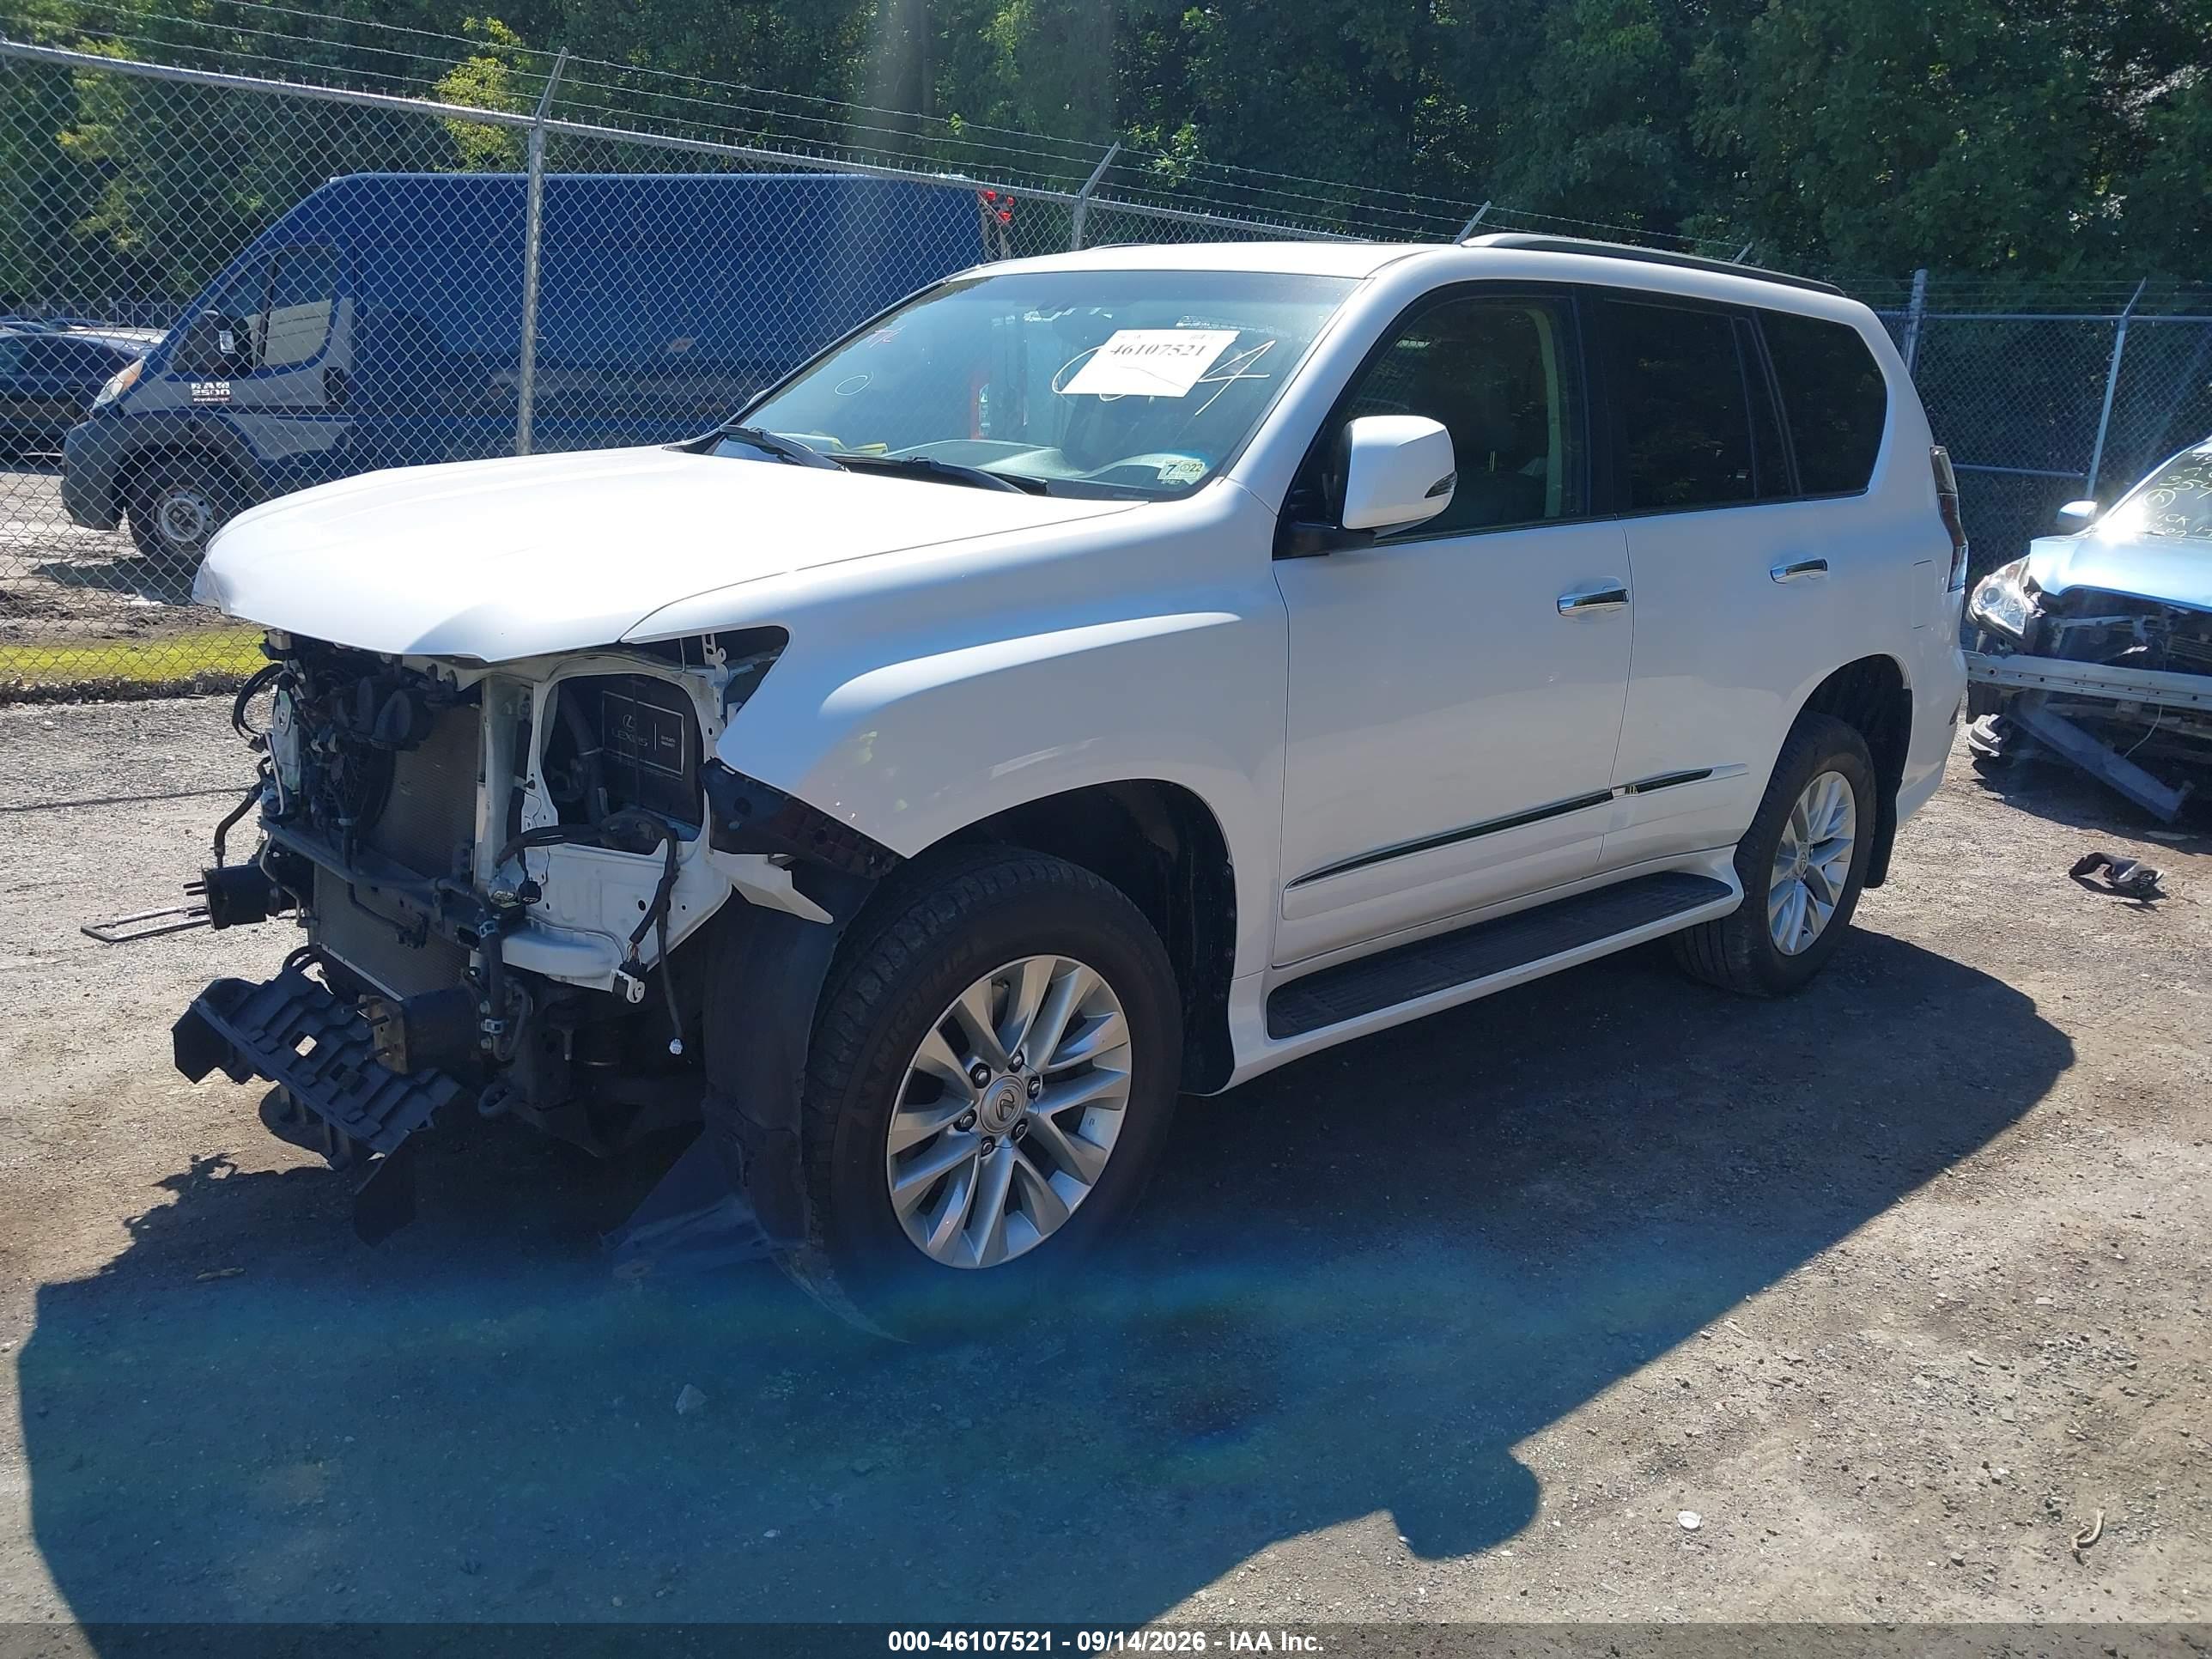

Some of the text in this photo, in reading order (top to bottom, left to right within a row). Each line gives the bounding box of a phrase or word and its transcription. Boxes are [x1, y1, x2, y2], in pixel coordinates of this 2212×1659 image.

[1109, 343, 1206, 356] 46107521
[1166, 465, 1177, 476] 7
[611, 727, 649, 747] LEXUS
